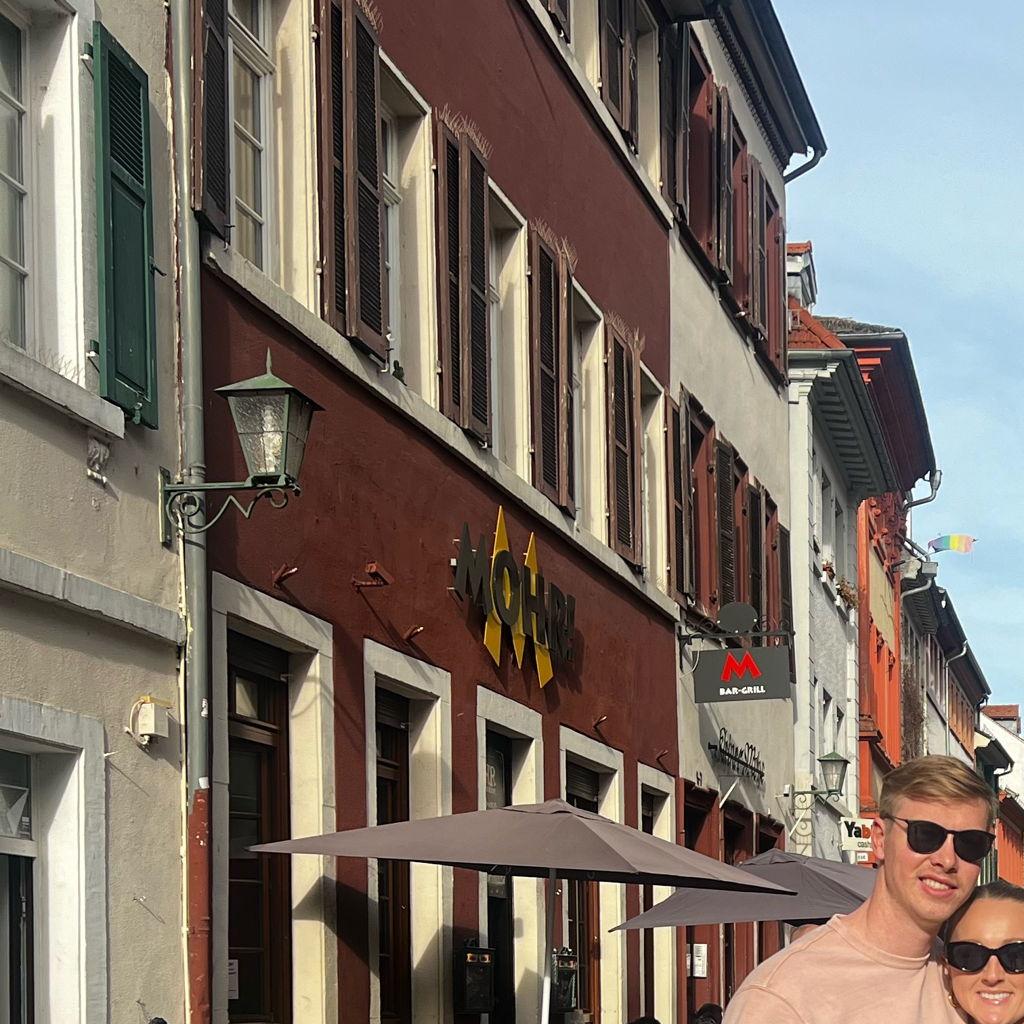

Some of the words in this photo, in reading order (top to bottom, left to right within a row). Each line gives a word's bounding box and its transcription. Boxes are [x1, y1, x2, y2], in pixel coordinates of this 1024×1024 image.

[720, 650, 762, 683] M
[720, 686, 766, 696] BAR-GRILL
[844, 821, 872, 839] Yab
